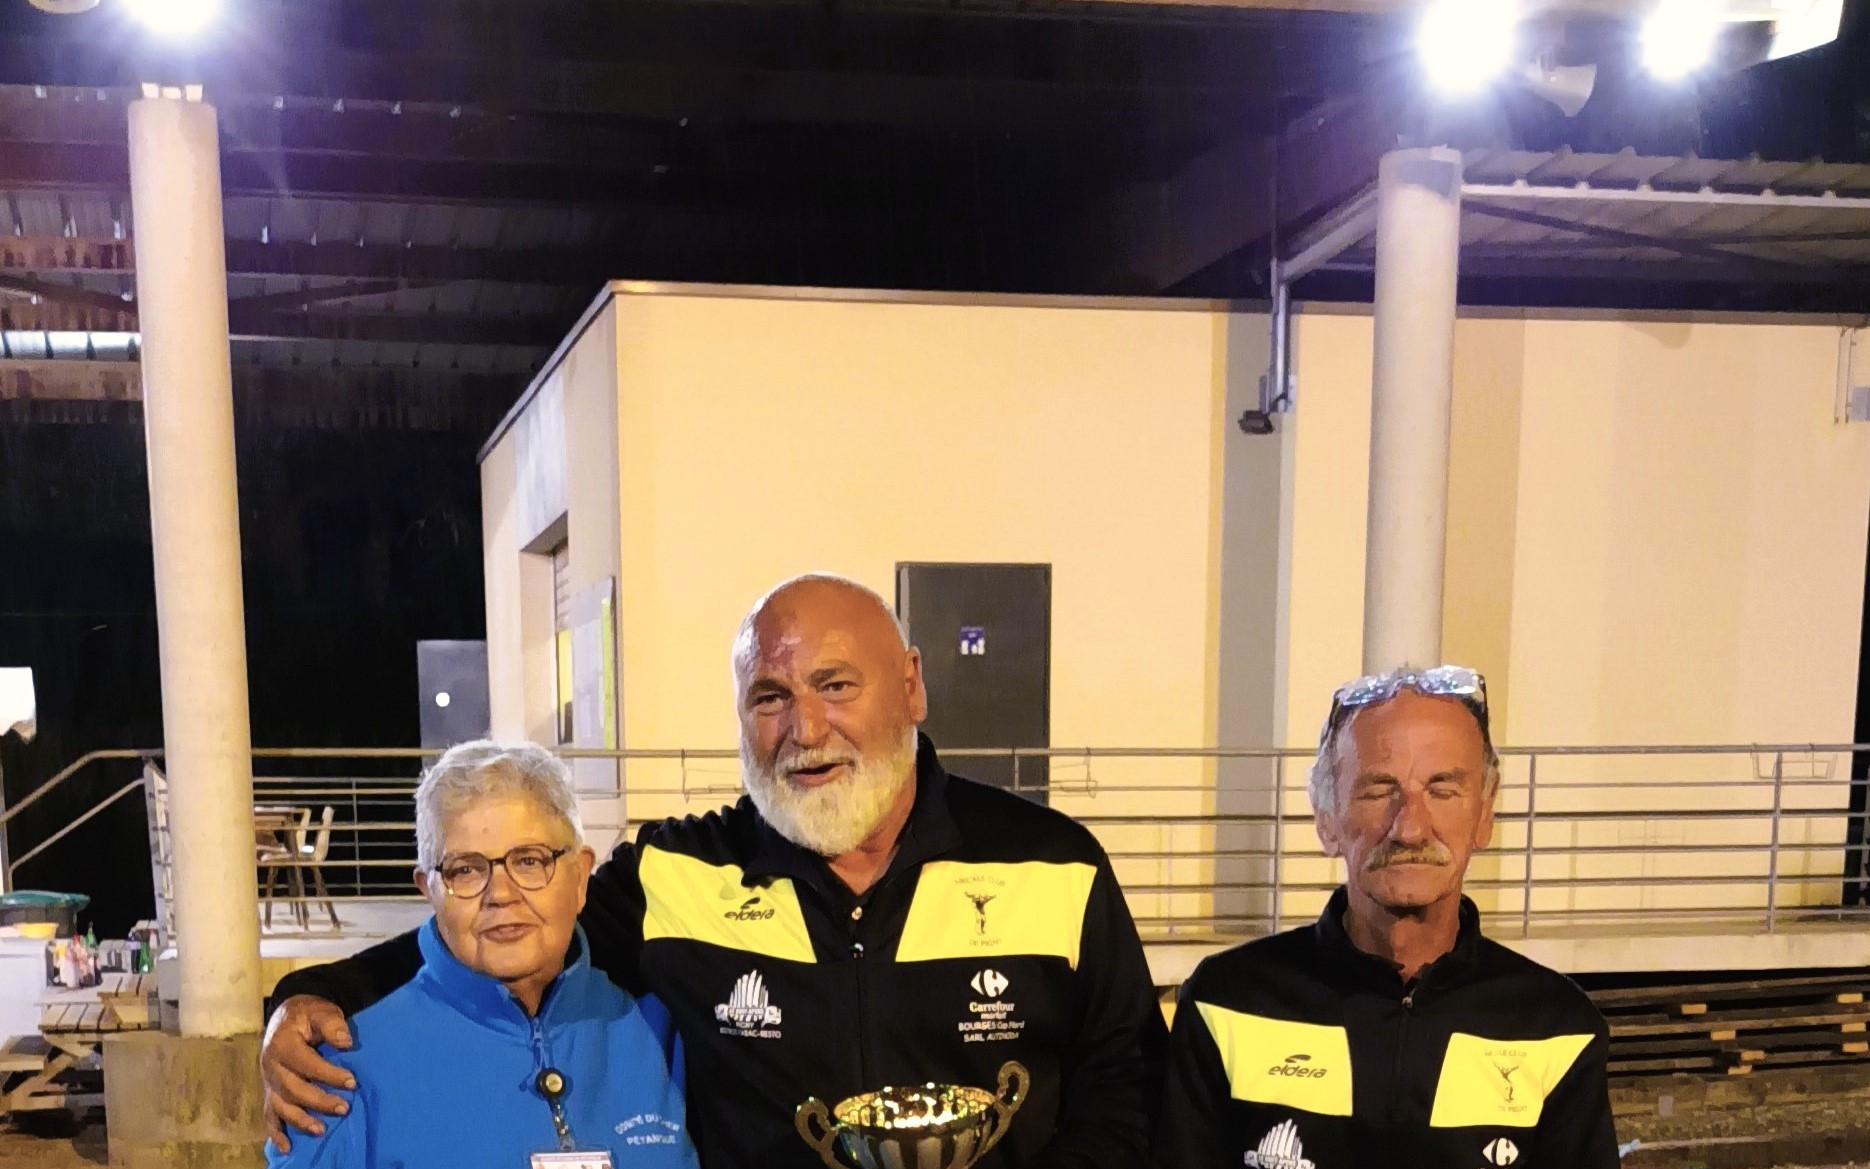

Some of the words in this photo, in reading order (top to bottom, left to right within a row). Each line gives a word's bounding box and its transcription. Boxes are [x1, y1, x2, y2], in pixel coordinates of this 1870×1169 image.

[969, 1001, 1015, 1013] Carrefour
[958, 1021, 996, 1032] BOURGES
[1267, 1064, 1328, 1079] eldera
